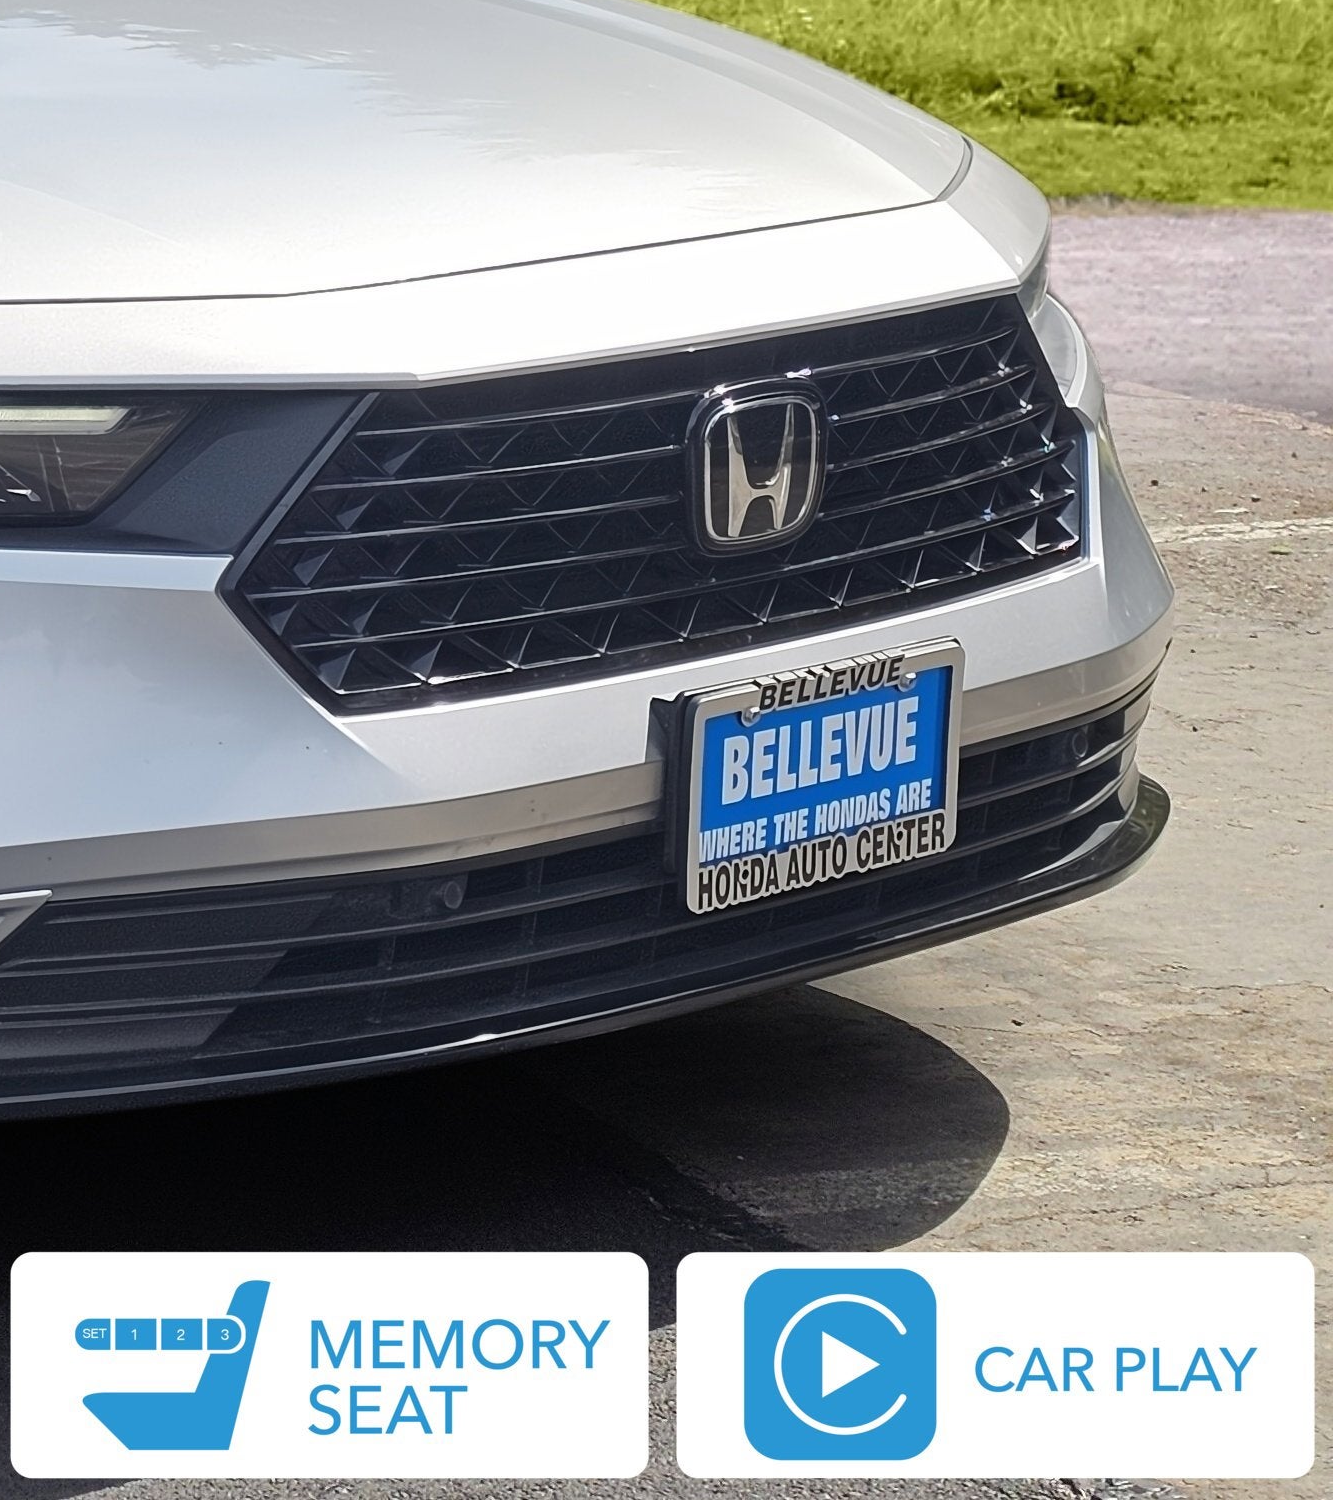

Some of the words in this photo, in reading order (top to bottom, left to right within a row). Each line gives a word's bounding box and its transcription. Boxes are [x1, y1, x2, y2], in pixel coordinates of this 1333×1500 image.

[759, 656, 905, 711] BELLEVUE
[721, 696, 919, 805] BELLEVUE
[698, 850, 780, 910] HONDA
[786, 835, 848, 888] AUTO
[856, 812, 946, 866] CENTER
[699, 818, 767, 862] WHERE
[773, 808, 808, 845] THE
[814, 788, 891, 837] HONDAS
[895, 778, 932, 813] ARE
